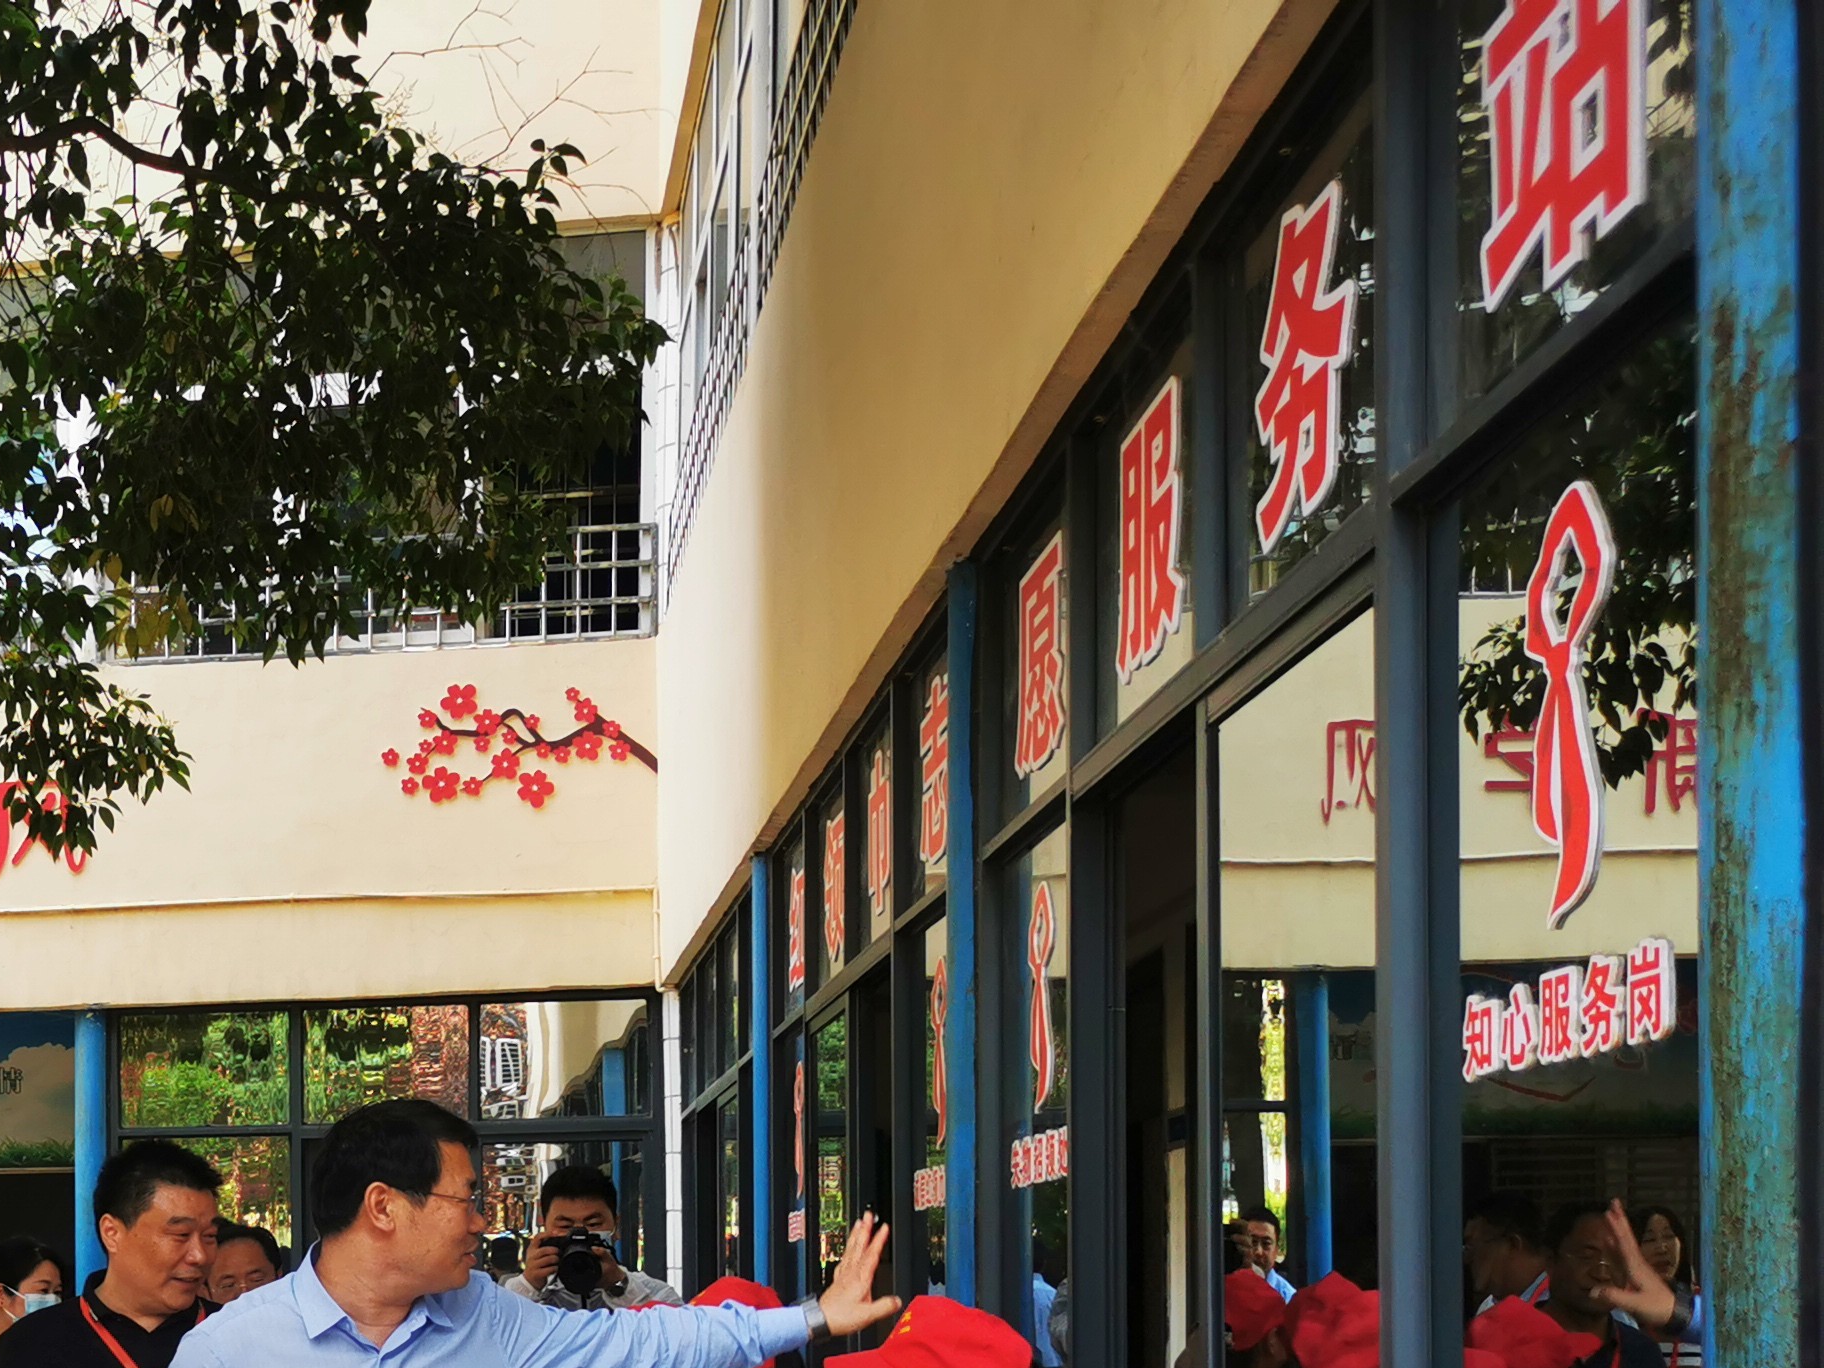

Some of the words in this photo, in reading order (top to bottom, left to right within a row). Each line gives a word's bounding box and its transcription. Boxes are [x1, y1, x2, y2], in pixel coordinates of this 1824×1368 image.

[1462, 938, 1675, 1083] 知心服务岗
